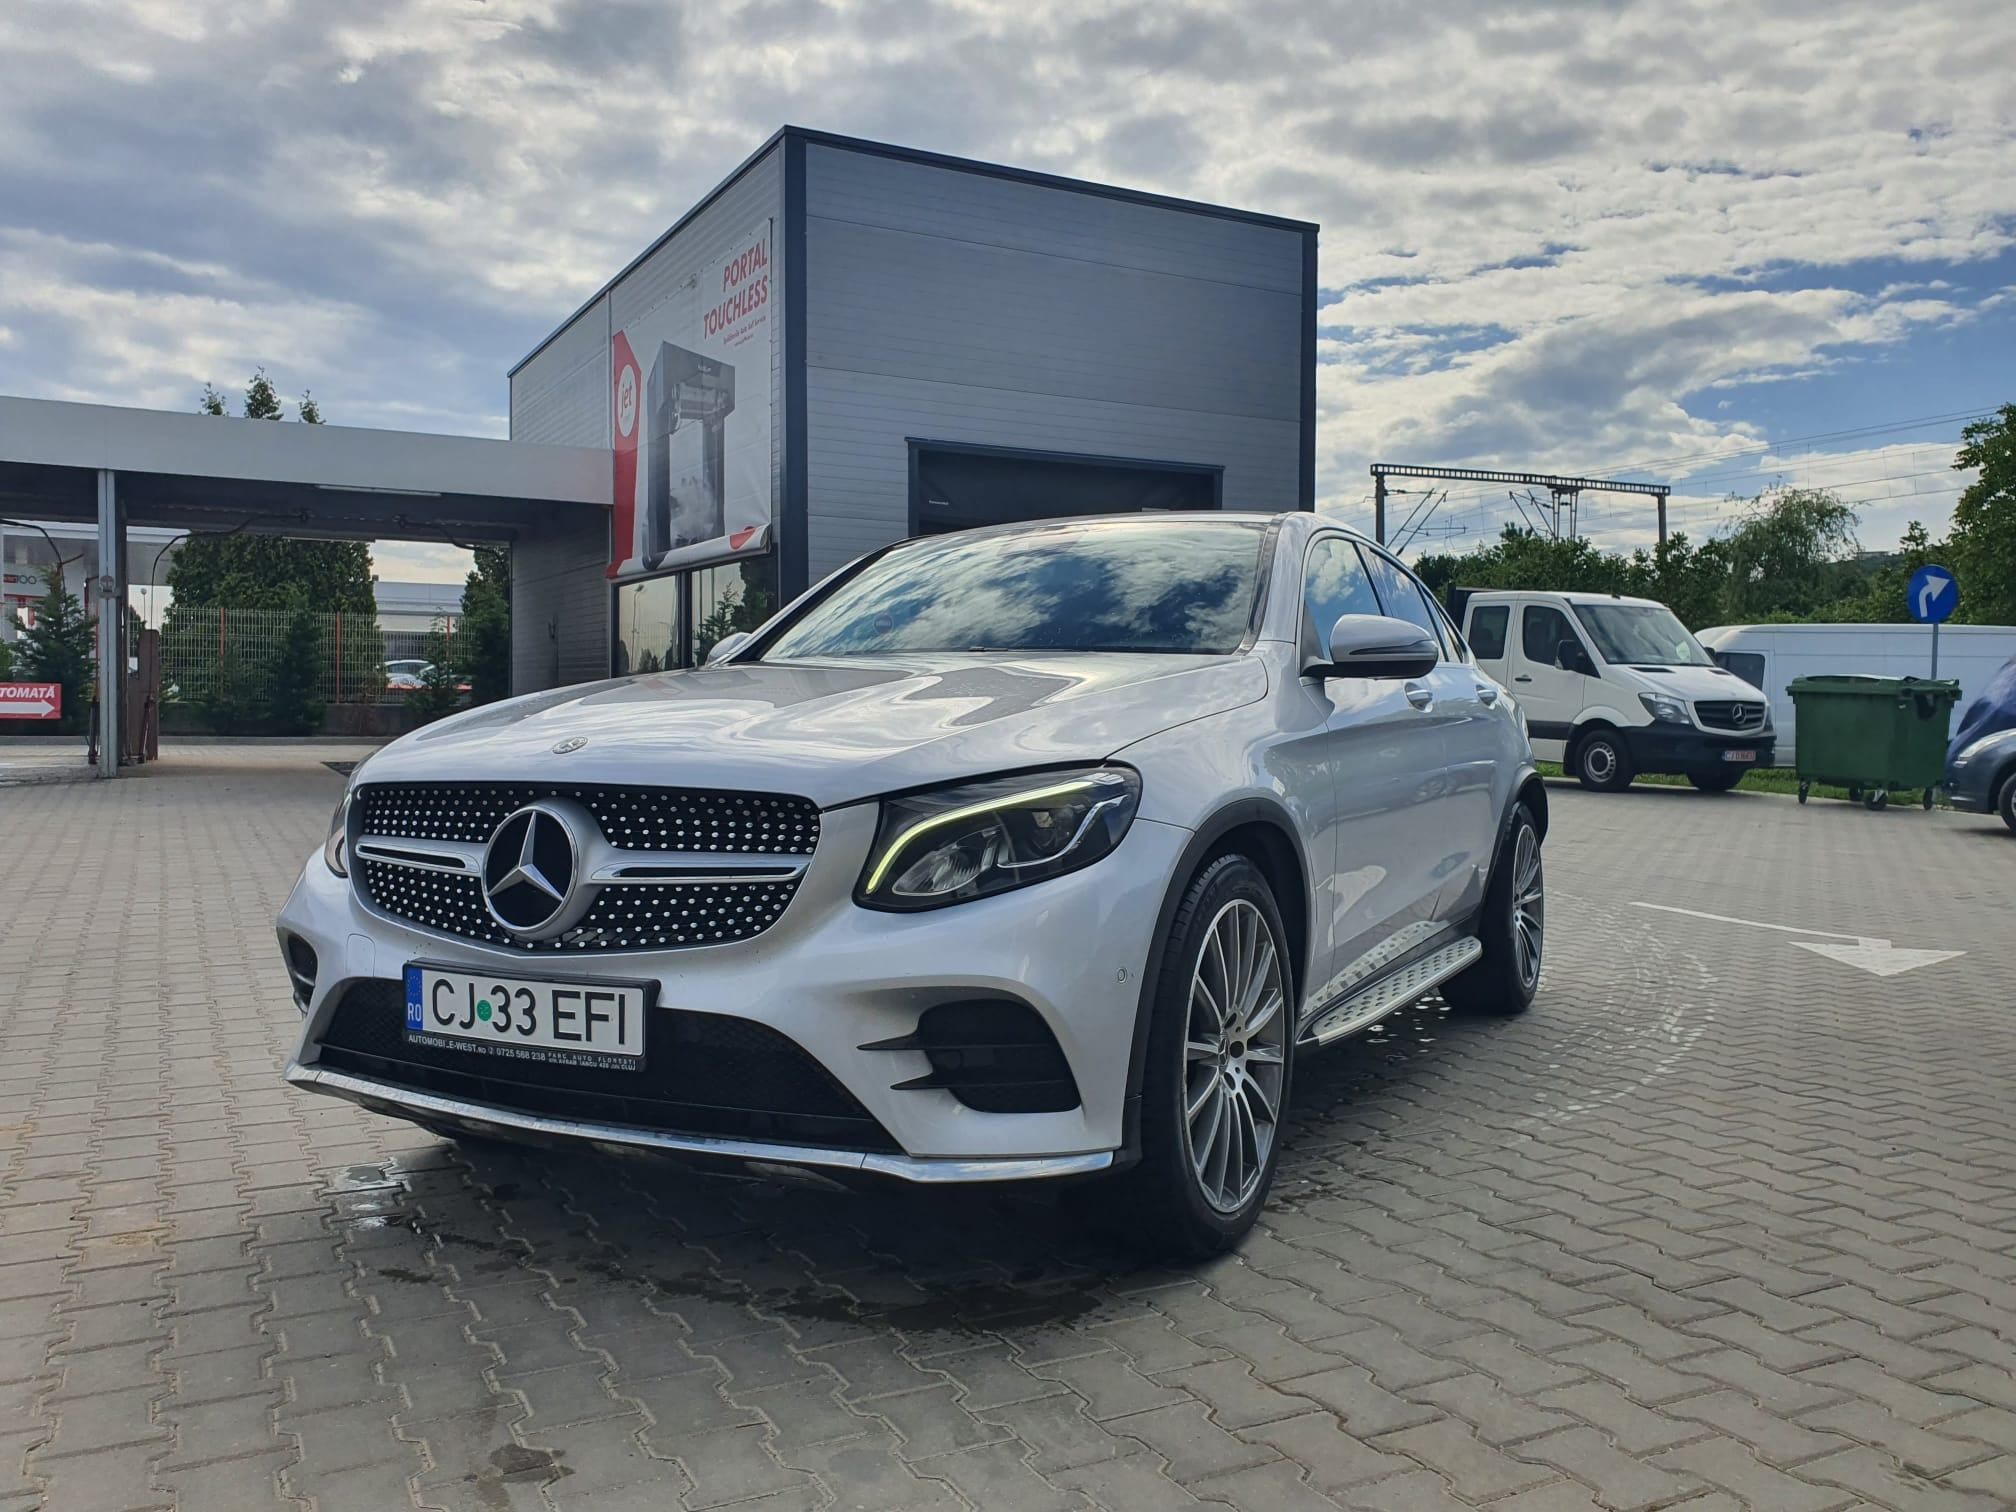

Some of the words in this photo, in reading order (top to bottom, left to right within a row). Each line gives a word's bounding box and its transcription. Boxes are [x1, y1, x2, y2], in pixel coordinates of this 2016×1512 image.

[723, 238, 768, 293] PORTAL
[704, 275, 768, 340] TOUCHLESS
[407, 1002, 423, 1021] RO
[432, 978, 475, 1030] CJ
[490, 984, 537, 1036] 33
[552, 989, 626, 1045] EFI
